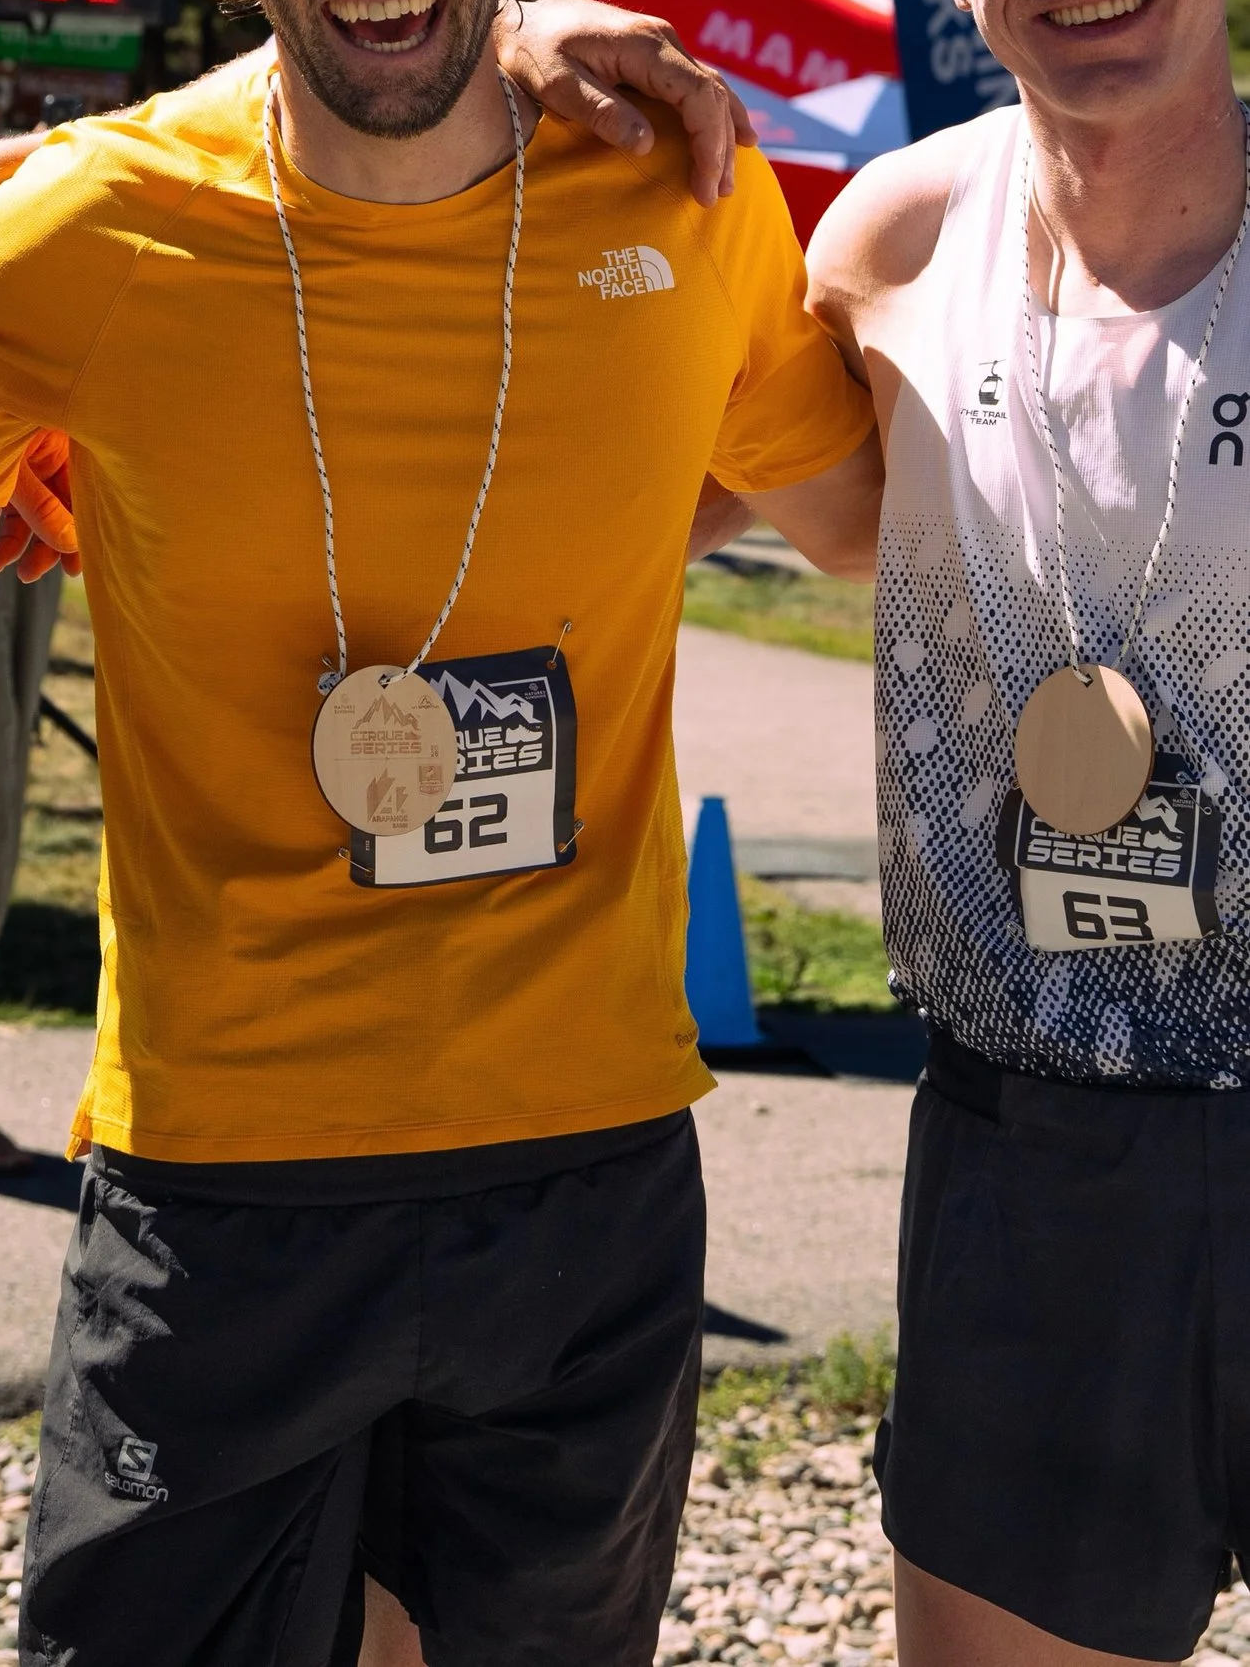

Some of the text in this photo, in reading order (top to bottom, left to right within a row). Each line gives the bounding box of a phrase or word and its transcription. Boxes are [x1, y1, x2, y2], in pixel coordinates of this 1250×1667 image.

[602, 247, 639, 266] THE
[577, 262, 643, 288] NORTH
[600, 278, 646, 300] FACE
[960, 408, 1007, 420] THE TRAIL
[970, 417, 997, 426] TEAM
[350, 730, 404, 742] CIRQUE
[351, 741, 422, 755] SERIES
[424, 793, 508, 855] 62
[1027, 838, 1182, 878] SERIES
[1062, 890, 1155, 942] 63
[104, 1471, 169, 1502] salomon
